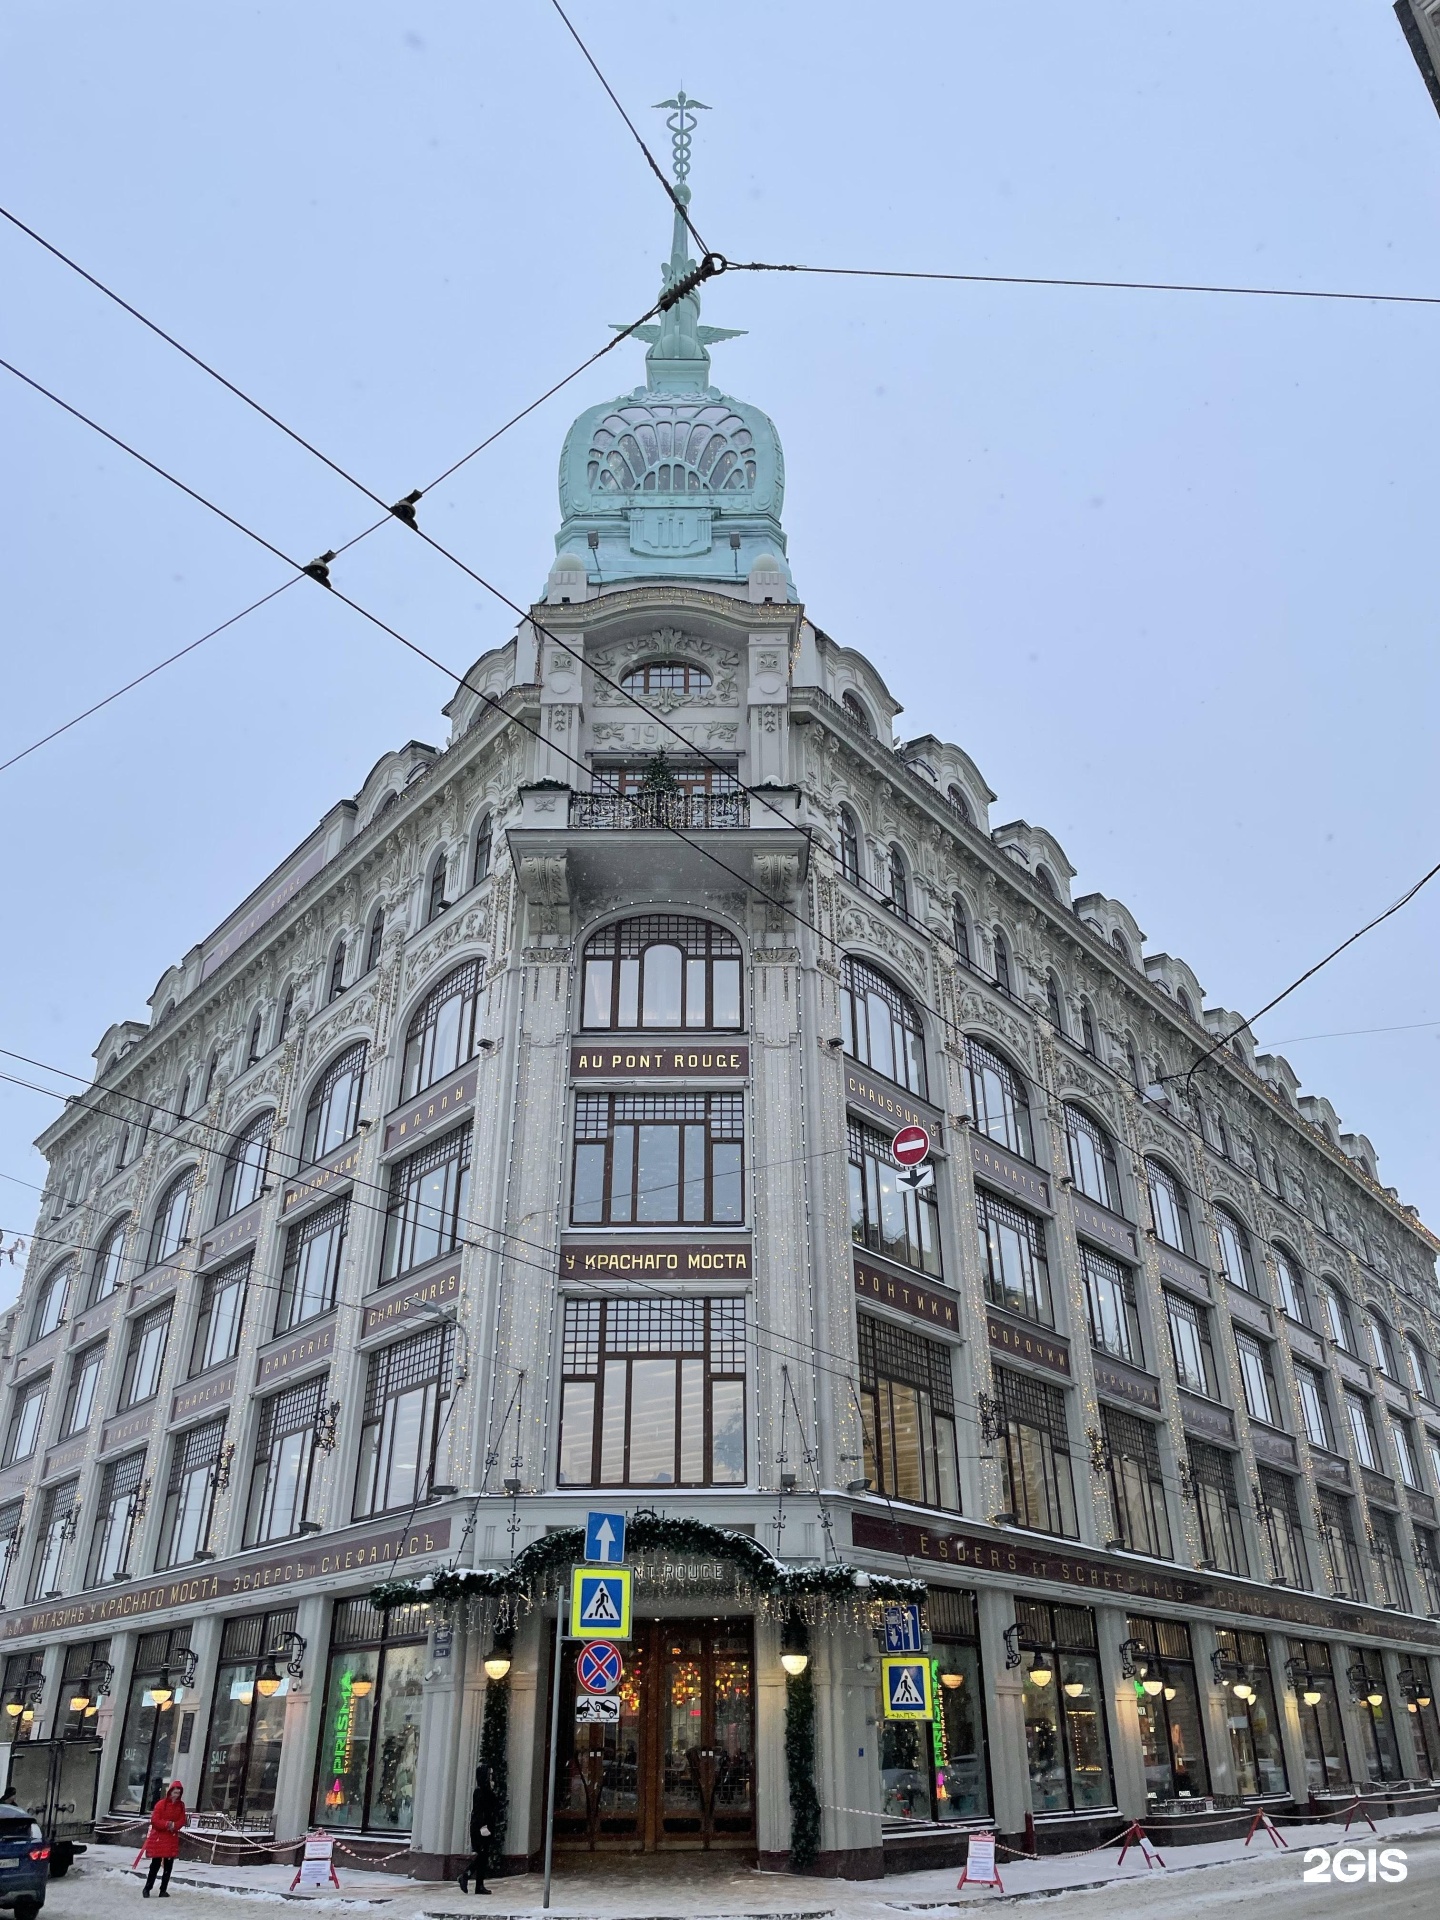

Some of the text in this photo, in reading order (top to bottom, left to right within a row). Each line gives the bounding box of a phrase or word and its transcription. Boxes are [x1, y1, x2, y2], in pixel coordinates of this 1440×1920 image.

[578, 1054, 740, 1069] AU PONT ROUGE
[399, 1085, 464, 1136] ШЛЯПЫ
[974, 1148, 1045, 1199] CRAVATES
[1074, 1205, 1133, 1249] BLOUSES
[565, 1253, 747, 1270] У КРАСНАГО МОСТА
[859, 1271, 953, 1323] ЗОНТИКИ
[663, 1563, 724, 1580] ROUGE
[920, 1536, 1017, 1570] ESDERS
[89, 1605, 96, 1621] У
[100, 1588, 165, 1618] КРАСНАГО
[170, 1576, 218, 1604] МОСТА
[333, 1669, 353, 1774] PRISMA
[123, 1748, 137, 1761] SALE
[211, 1750, 227, 1765] SALE
